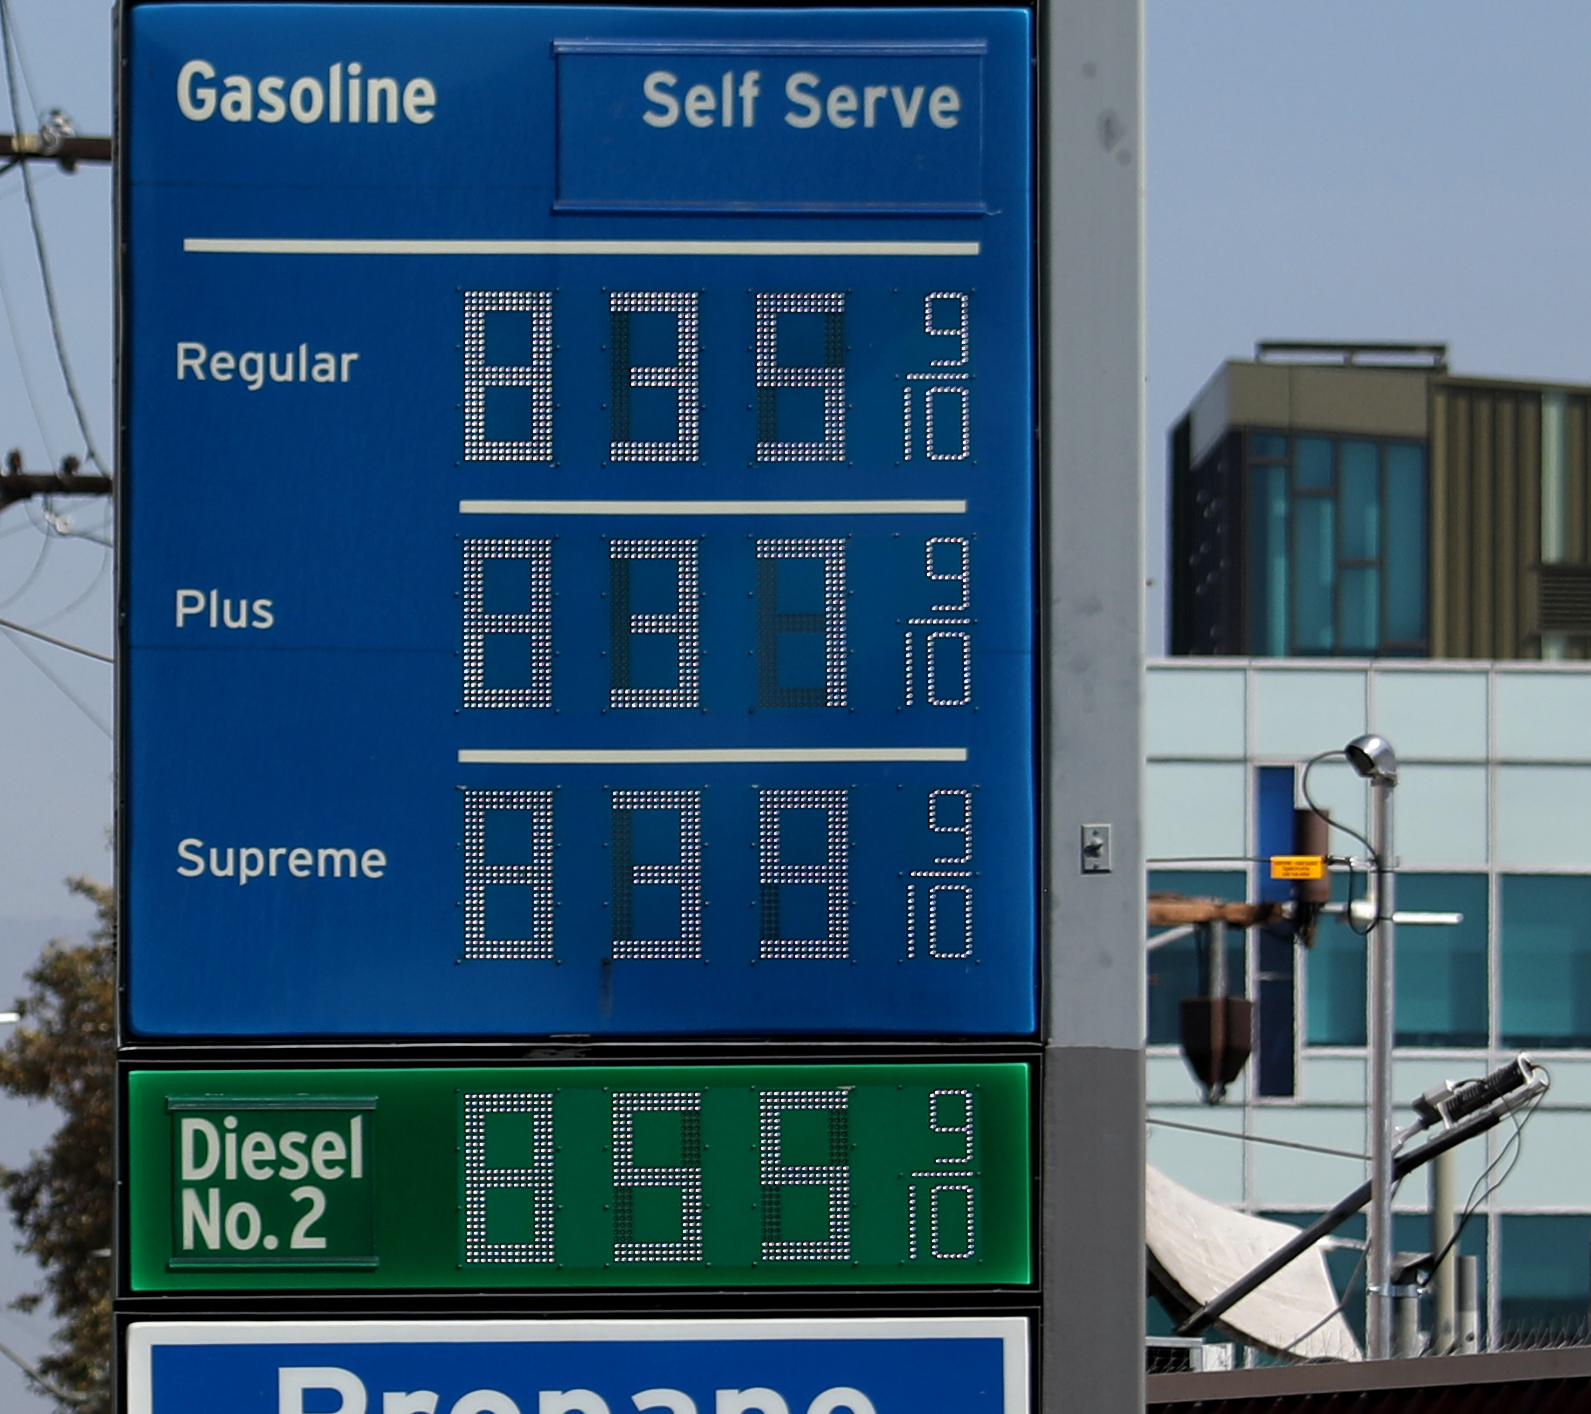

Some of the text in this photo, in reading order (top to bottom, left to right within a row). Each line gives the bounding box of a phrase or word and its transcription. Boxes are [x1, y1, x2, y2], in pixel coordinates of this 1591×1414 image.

[176, 58, 962, 130] Gasoline Self Serve
[174, 341, 359, 391] Regular
[173, 589, 275, 630] Plus
[175, 837, 387, 891] Supreme
[180, 1115, 365, 1181] Diesel
